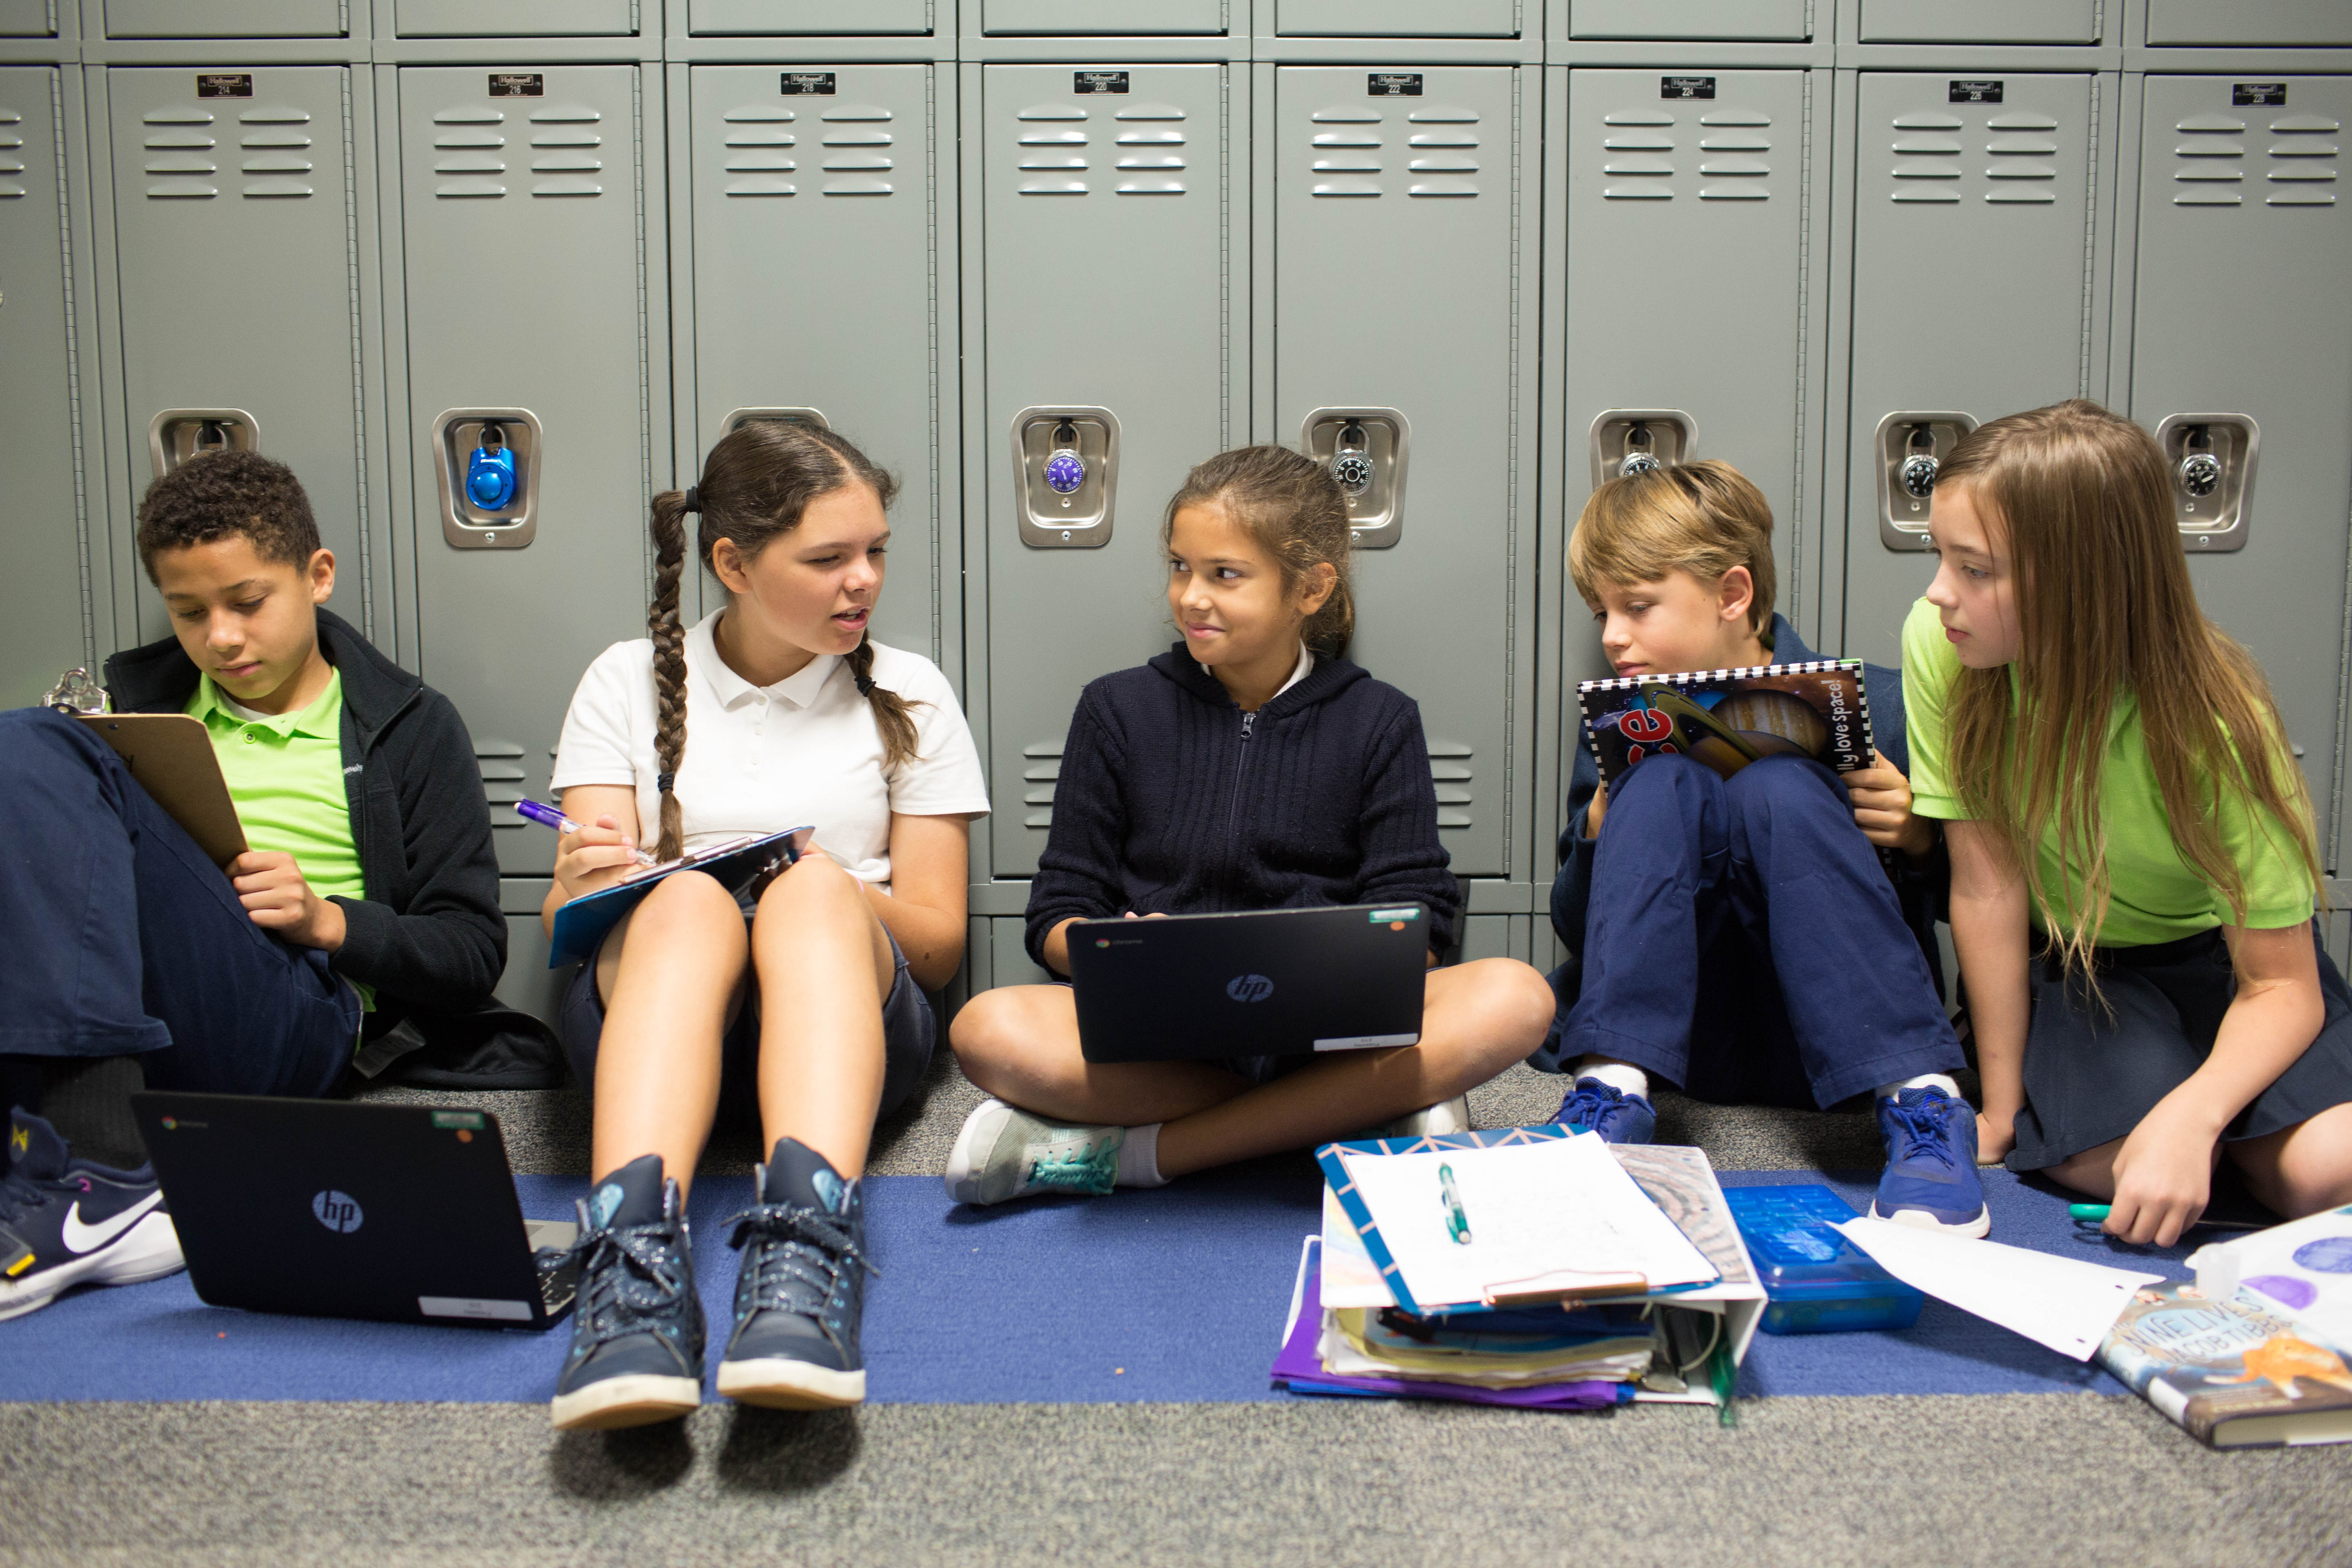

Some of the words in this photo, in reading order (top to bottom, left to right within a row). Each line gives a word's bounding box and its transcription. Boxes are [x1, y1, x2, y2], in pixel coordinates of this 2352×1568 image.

[802, 84, 813, 92] 218
[1095, 82, 1107, 91] 220
[1388, 85, 1401, 93] 222
[1682, 88, 1694, 96] 224
[1820, 679, 1853, 722] space!
[1833, 724, 1852, 752] love
[1233, 974, 1267, 1003] hp
[322, 1189, 355, 1234] hp
[2120, 1317, 2192, 1356] NINE
[2183, 1296, 2264, 1332] LIVES
[2163, 1336, 2229, 1365] JACOB
[2222, 1314, 2292, 1342] TIBBS
